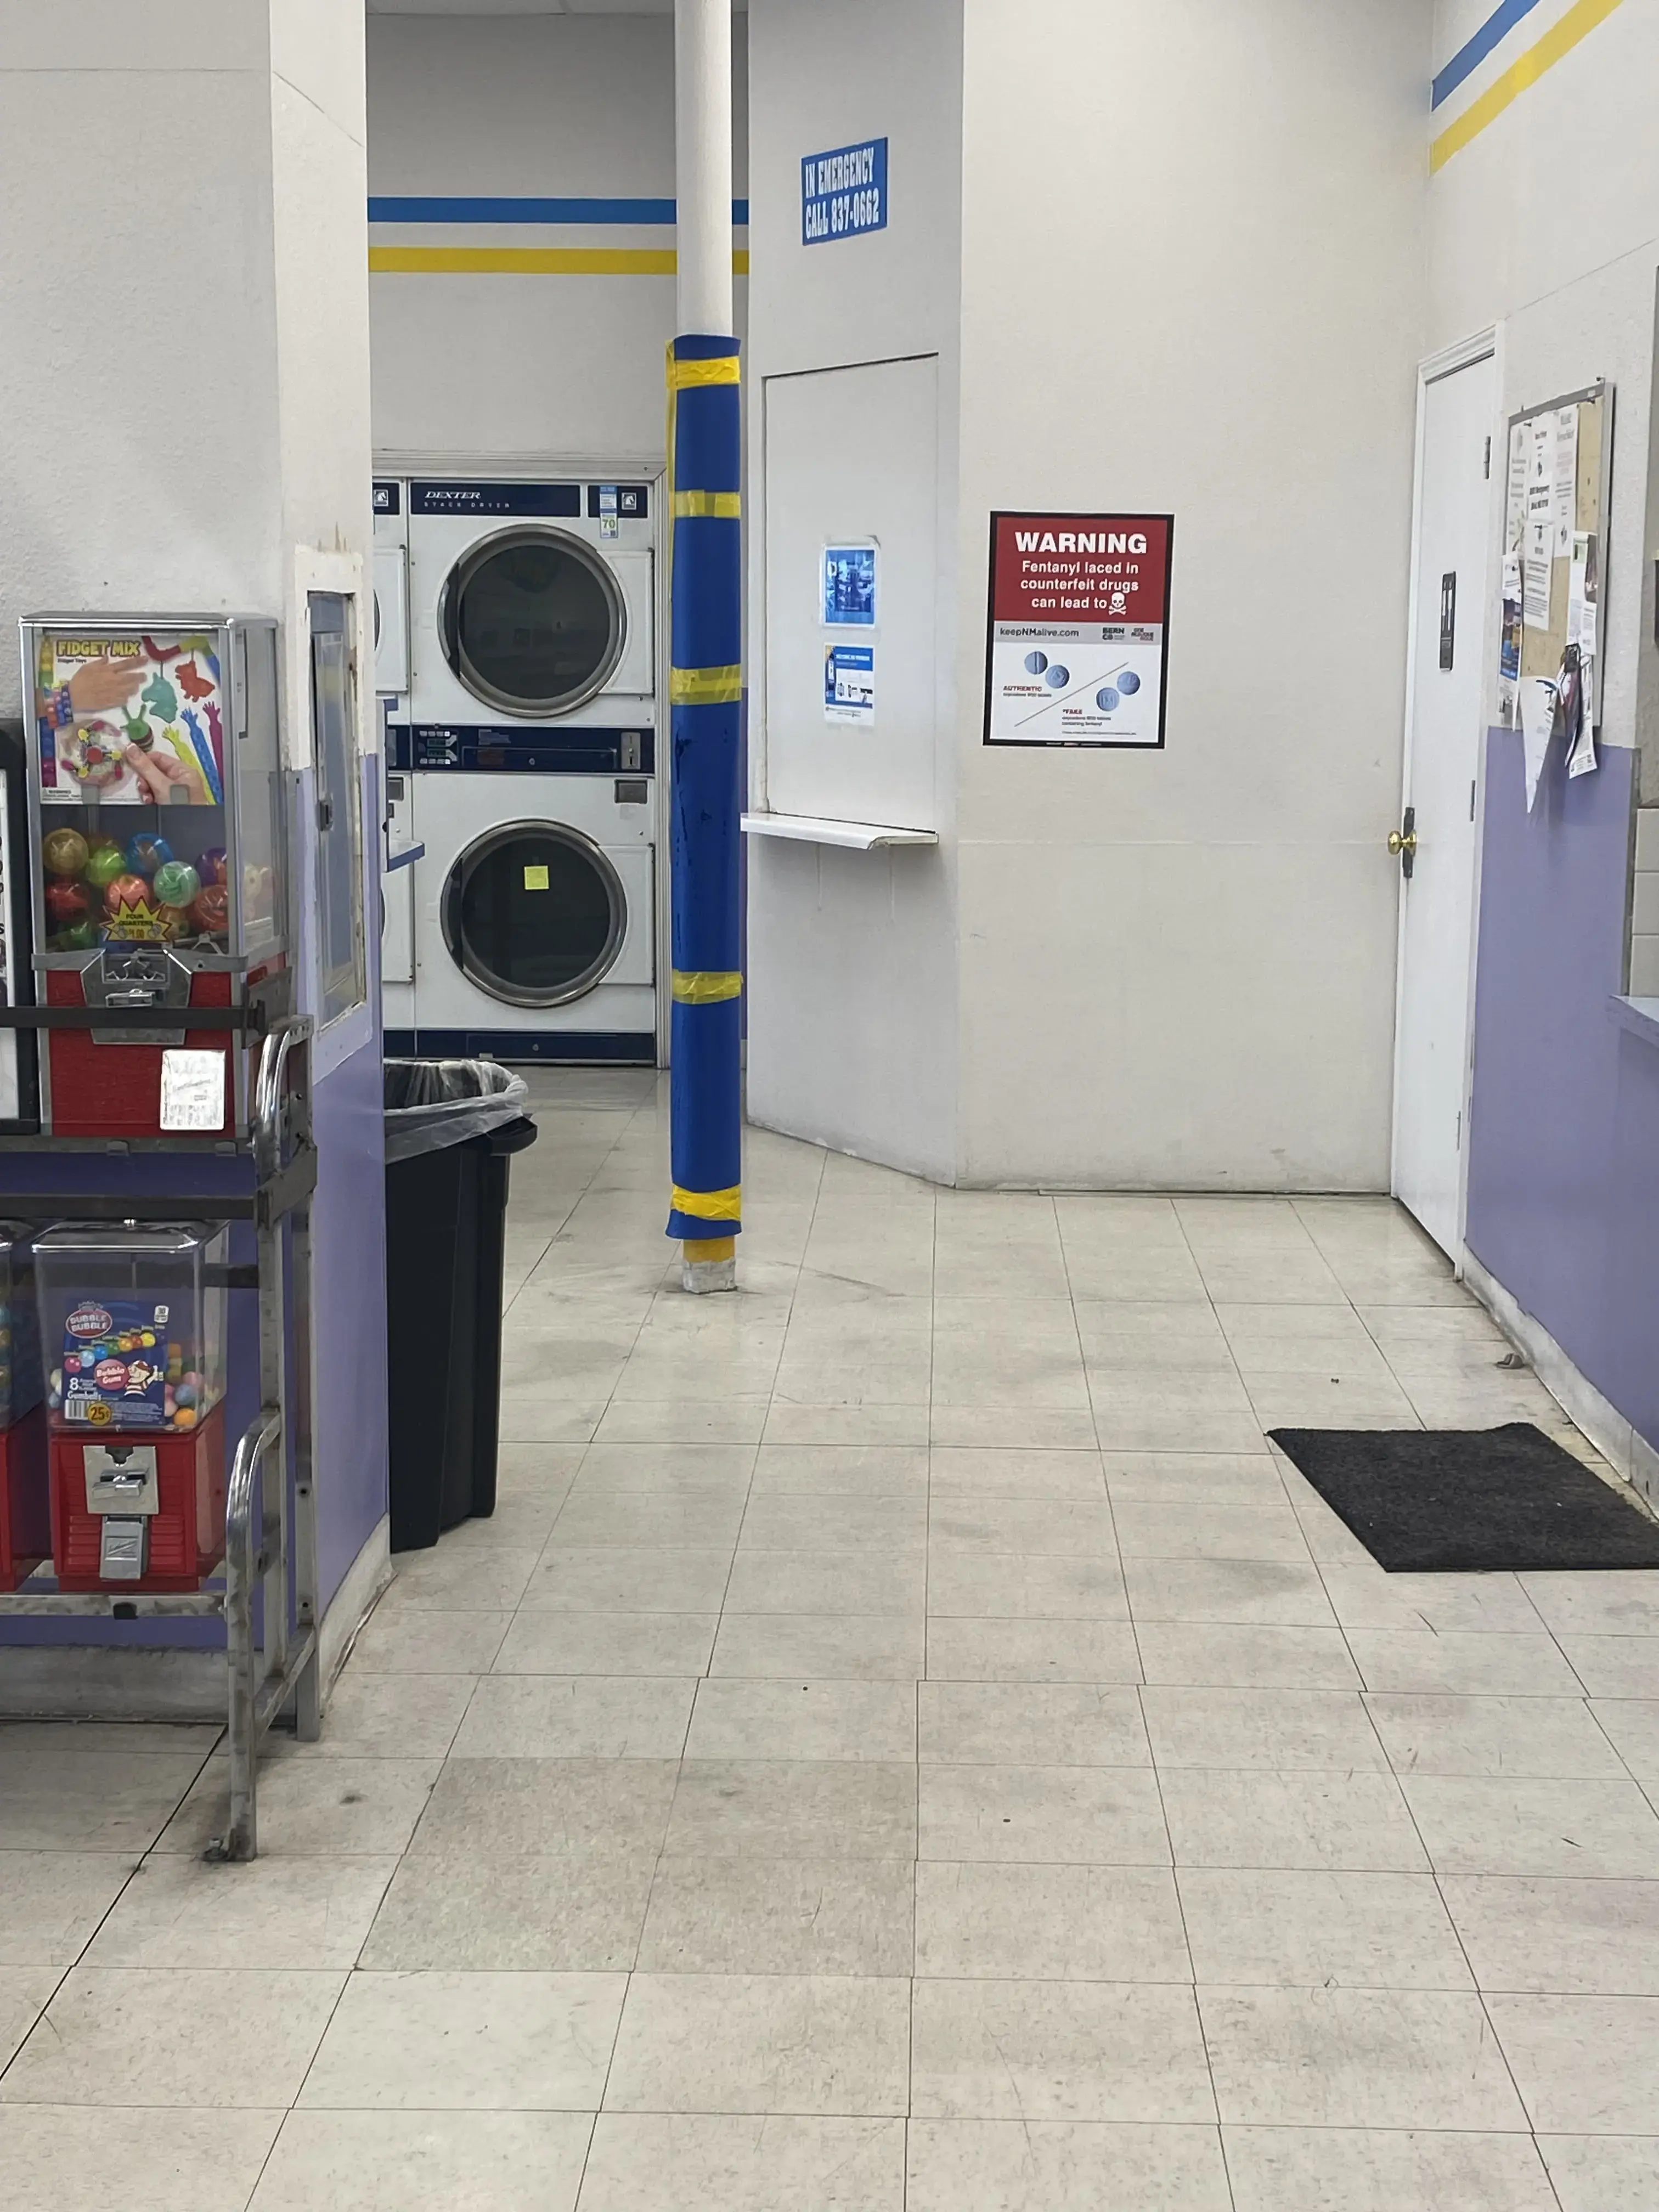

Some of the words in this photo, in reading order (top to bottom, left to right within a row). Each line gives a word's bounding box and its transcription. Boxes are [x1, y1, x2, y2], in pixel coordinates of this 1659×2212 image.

[805, 163, 815, 199] IN
[818, 146, 874, 195] EMERGENCY
[805, 201, 828, 239] CALL
[831, 188, 879, 233] 837-0662
[602, 519, 616, 529] 70
[1015, 532, 1147, 554] WARNING
[1022, 560, 1080, 575] Fentanyl
[1085, 562, 1122, 574] laced
[1126, 562, 1139, 574] in
[1020, 579, 1094, 591] counterfeit
[1099, 580, 1139, 593] drugs
[1031, 598, 1056, 608] can
[1060, 596, 1090, 608] lead
[1094, 597, 1107, 608] to
[1000, 628, 1079, 637] keepNMalive.com
[57, 640, 109, 657] FIDGET
[111, 640, 140, 657] MIX
[96, 1365, 125, 1378] Bubble
[70, 1377, 79, 1390] 8
[102, 1375, 122, 1384] Gum
